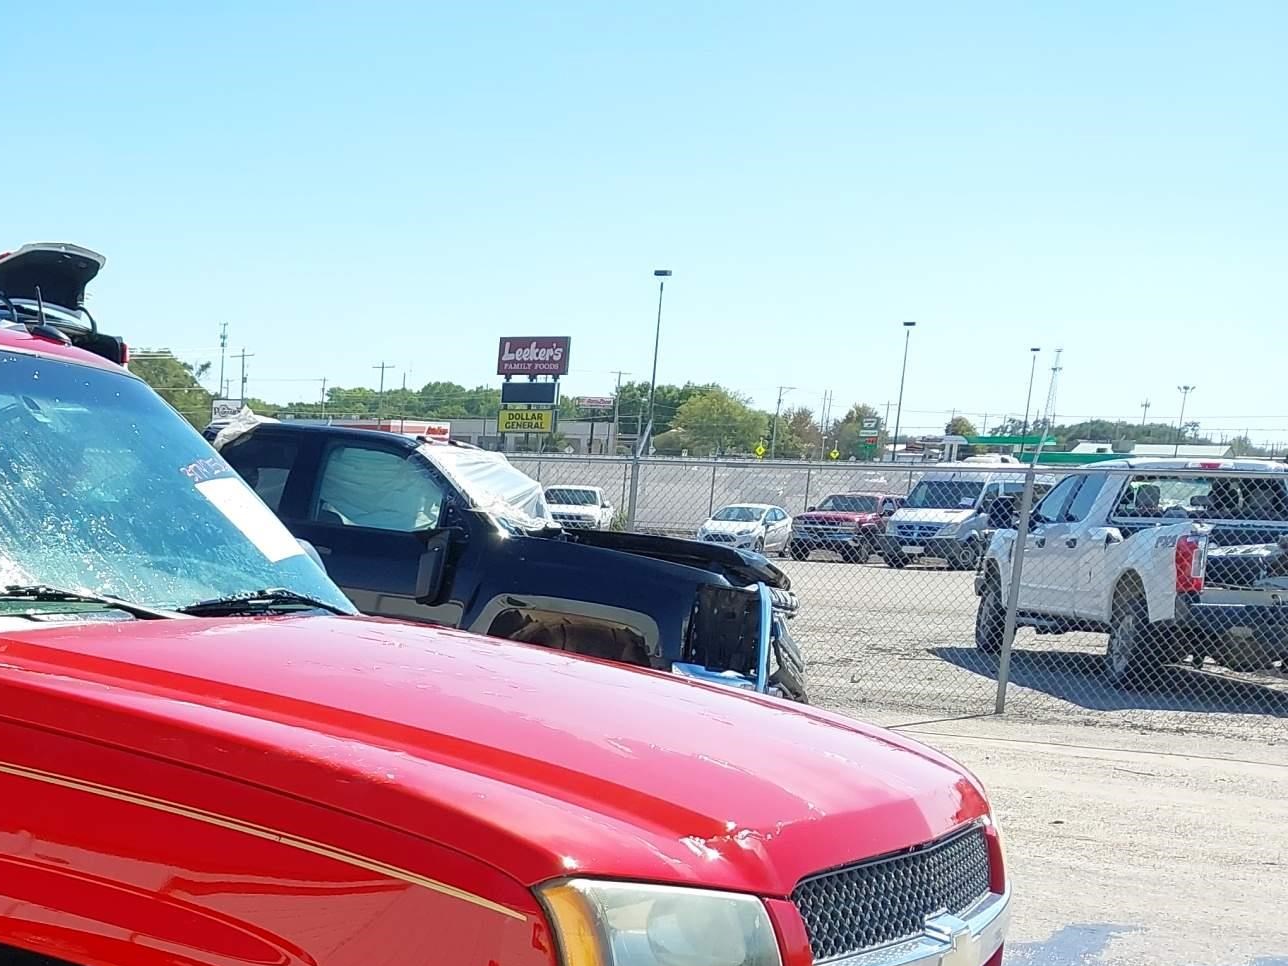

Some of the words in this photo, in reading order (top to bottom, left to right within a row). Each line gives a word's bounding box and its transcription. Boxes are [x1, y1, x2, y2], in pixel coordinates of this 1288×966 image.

[502, 341, 563, 361] Leeker's
[504, 362, 532, 370] FAMILY
[534, 362, 559, 370] FOODS
[508, 412, 543, 421] DOLLAR
[505, 421, 545, 430] GENERAL
